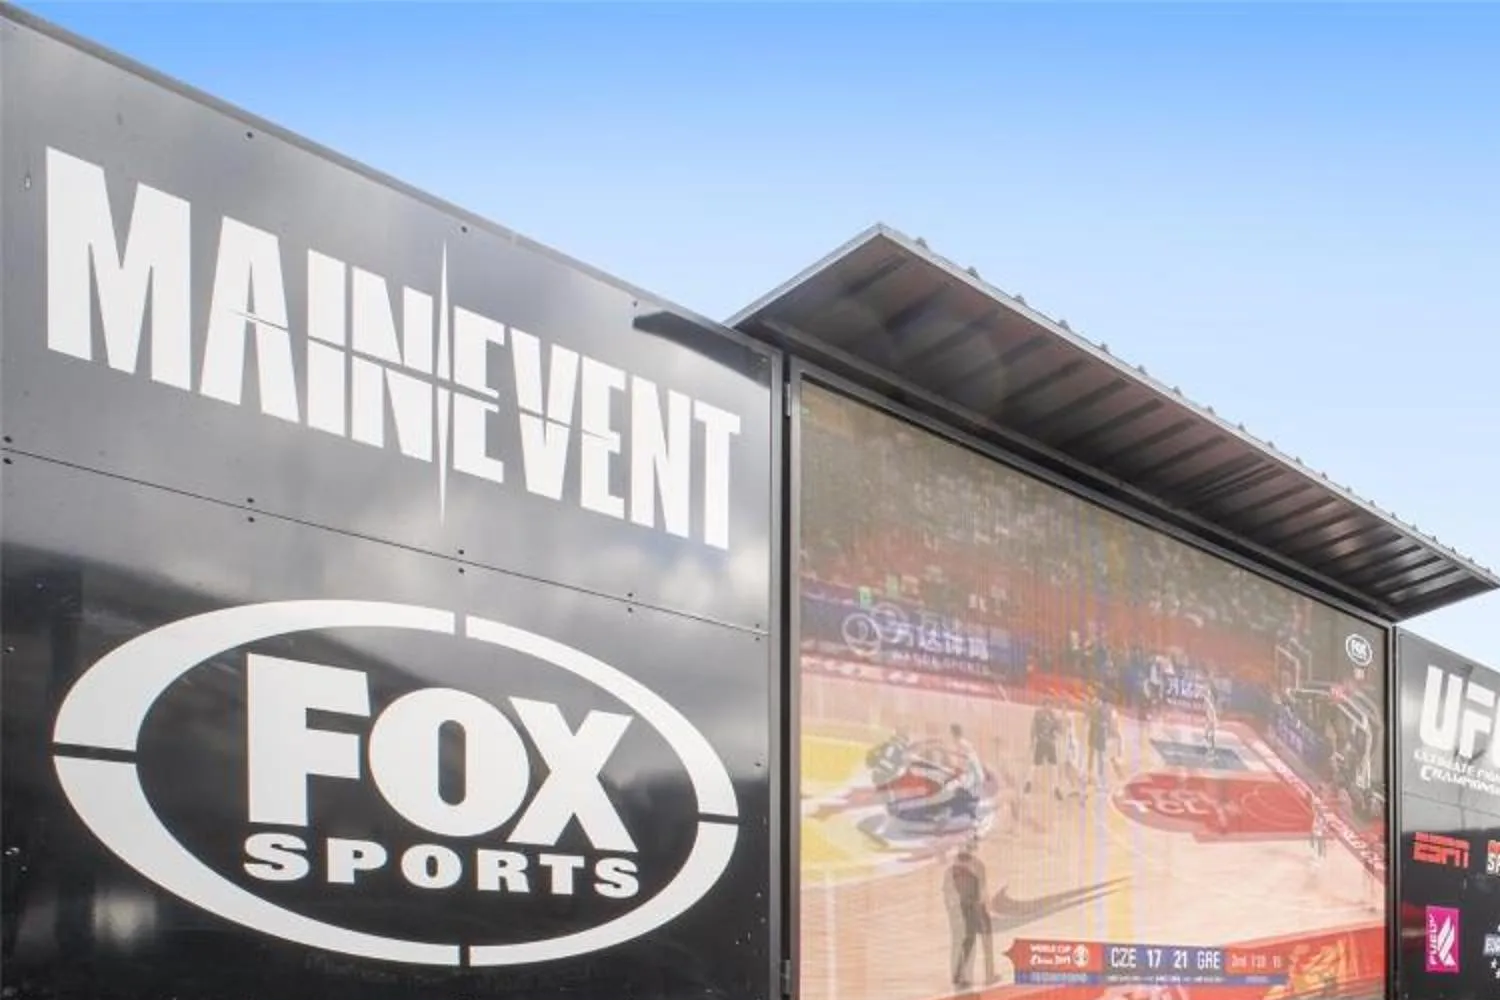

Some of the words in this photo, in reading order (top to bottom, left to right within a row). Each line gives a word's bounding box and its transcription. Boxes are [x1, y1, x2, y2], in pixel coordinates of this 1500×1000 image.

[247, 653, 638, 853] FOX
[243, 833, 640, 899] SPORTS
[1413, 832, 1470, 868] ESPN
[1111, 947, 1137, 968] CZE
[1147, 949, 1161, 968] 17
[1173, 950, 1188, 969] 21
[1197, 950, 1222, 969] GRE
